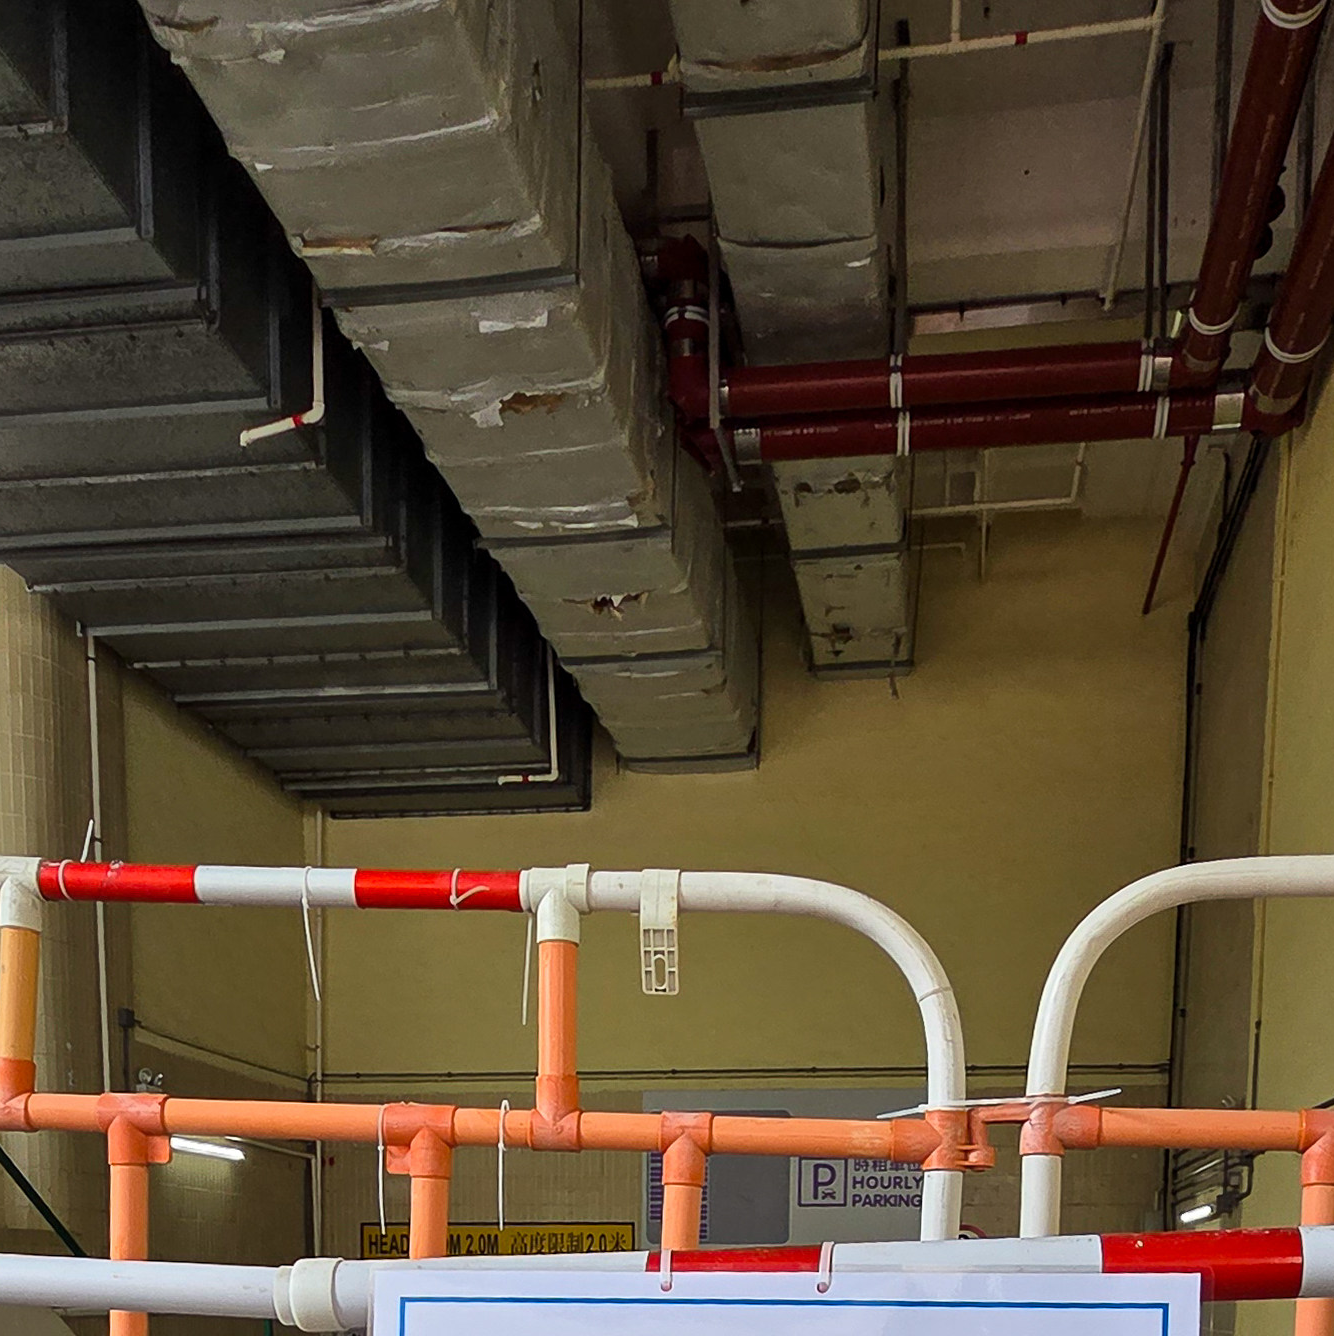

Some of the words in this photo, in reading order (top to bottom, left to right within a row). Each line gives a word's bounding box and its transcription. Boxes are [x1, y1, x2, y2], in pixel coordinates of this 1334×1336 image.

[813, 1163, 837, 1200] P
[852, 1175, 923, 1189] HOURLY
[852, 1194, 922, 1207] PARKING
[465, 1233, 499, 1255] 2.0M
